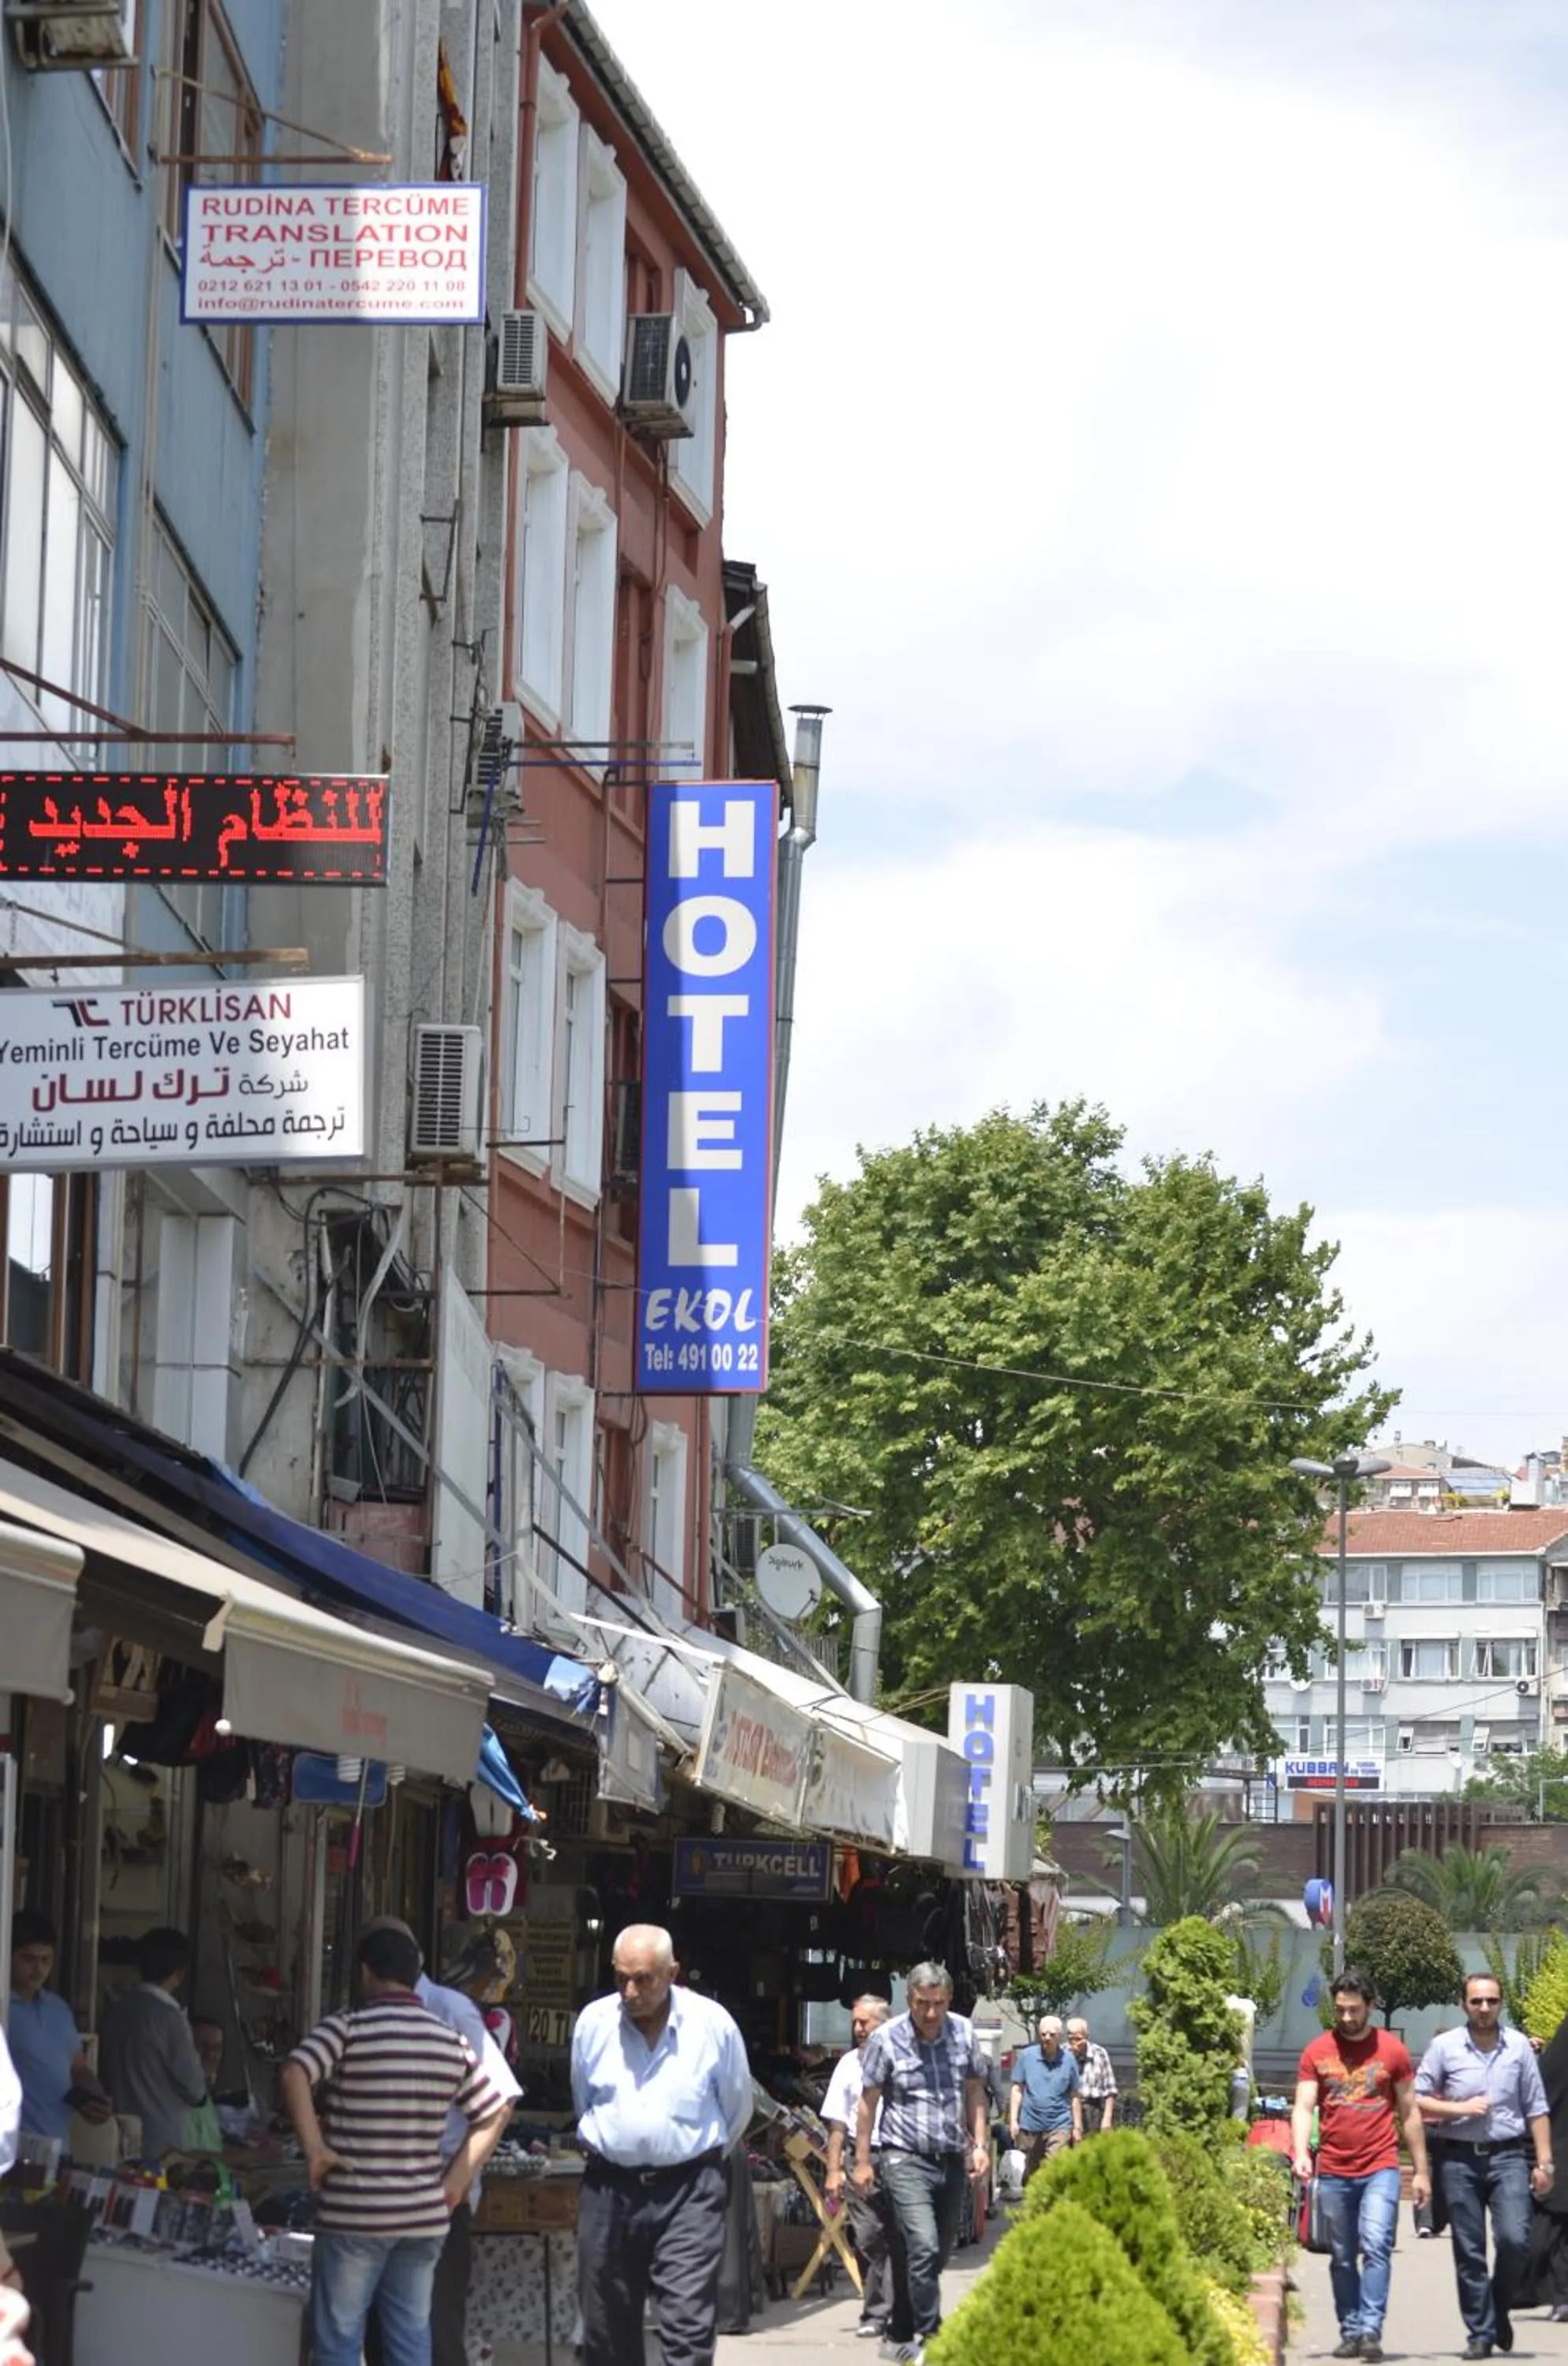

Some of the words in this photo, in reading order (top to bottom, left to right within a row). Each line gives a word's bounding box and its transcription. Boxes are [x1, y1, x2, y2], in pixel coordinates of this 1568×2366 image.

[202, 192, 315, 216] RUDİNA
[324, 192, 470, 216] TERCÜME
[201, 224, 469, 243] TRANSLATION
[200, 242, 286, 274] ترجمة
[310, 248, 468, 272] ПЕРЕВОД
[198, 279, 239, 293] 0212
[243, 279, 273, 293] 621
[281, 279, 299, 293] 13
[304, 279, 323, 293] 01
[340, 279, 381, 293] 0542
[386, 279, 416, 293] 220
[424, 279, 439, 293] 11
[197, 297, 465, 312] info@rudinatercume.com
[28, 782, 191, 858] الجديد
[120, 988, 292, 1026] TÜRKLİSAN
[93, 1033, 201, 1060] Tercüme
[208, 1030, 241, 1055] Ve
[248, 1027, 349, 1059] Seyahat
[662, 800, 757, 1267] HOTEL
[32, 1069, 144, 1113] لسان
[151, 1066, 230, 1106] ترك
[238, 1069, 308, 1099] شركة
[110, 1116, 178, 1150] سياحة
[205, 1110, 275, 1140] محلفة
[282, 1106, 345, 1140] ترجمة
[645, 1286, 757, 1334] EKOL
[644, 1342, 674, 1371] Tel:
[678, 1342, 707, 1371] 491
[711, 1342, 733, 1372] 00
[737, 1342, 758, 1371] 22
[963, 1693, 996, 1869] HOTEL
[530, 2010, 550, 2043] 20
